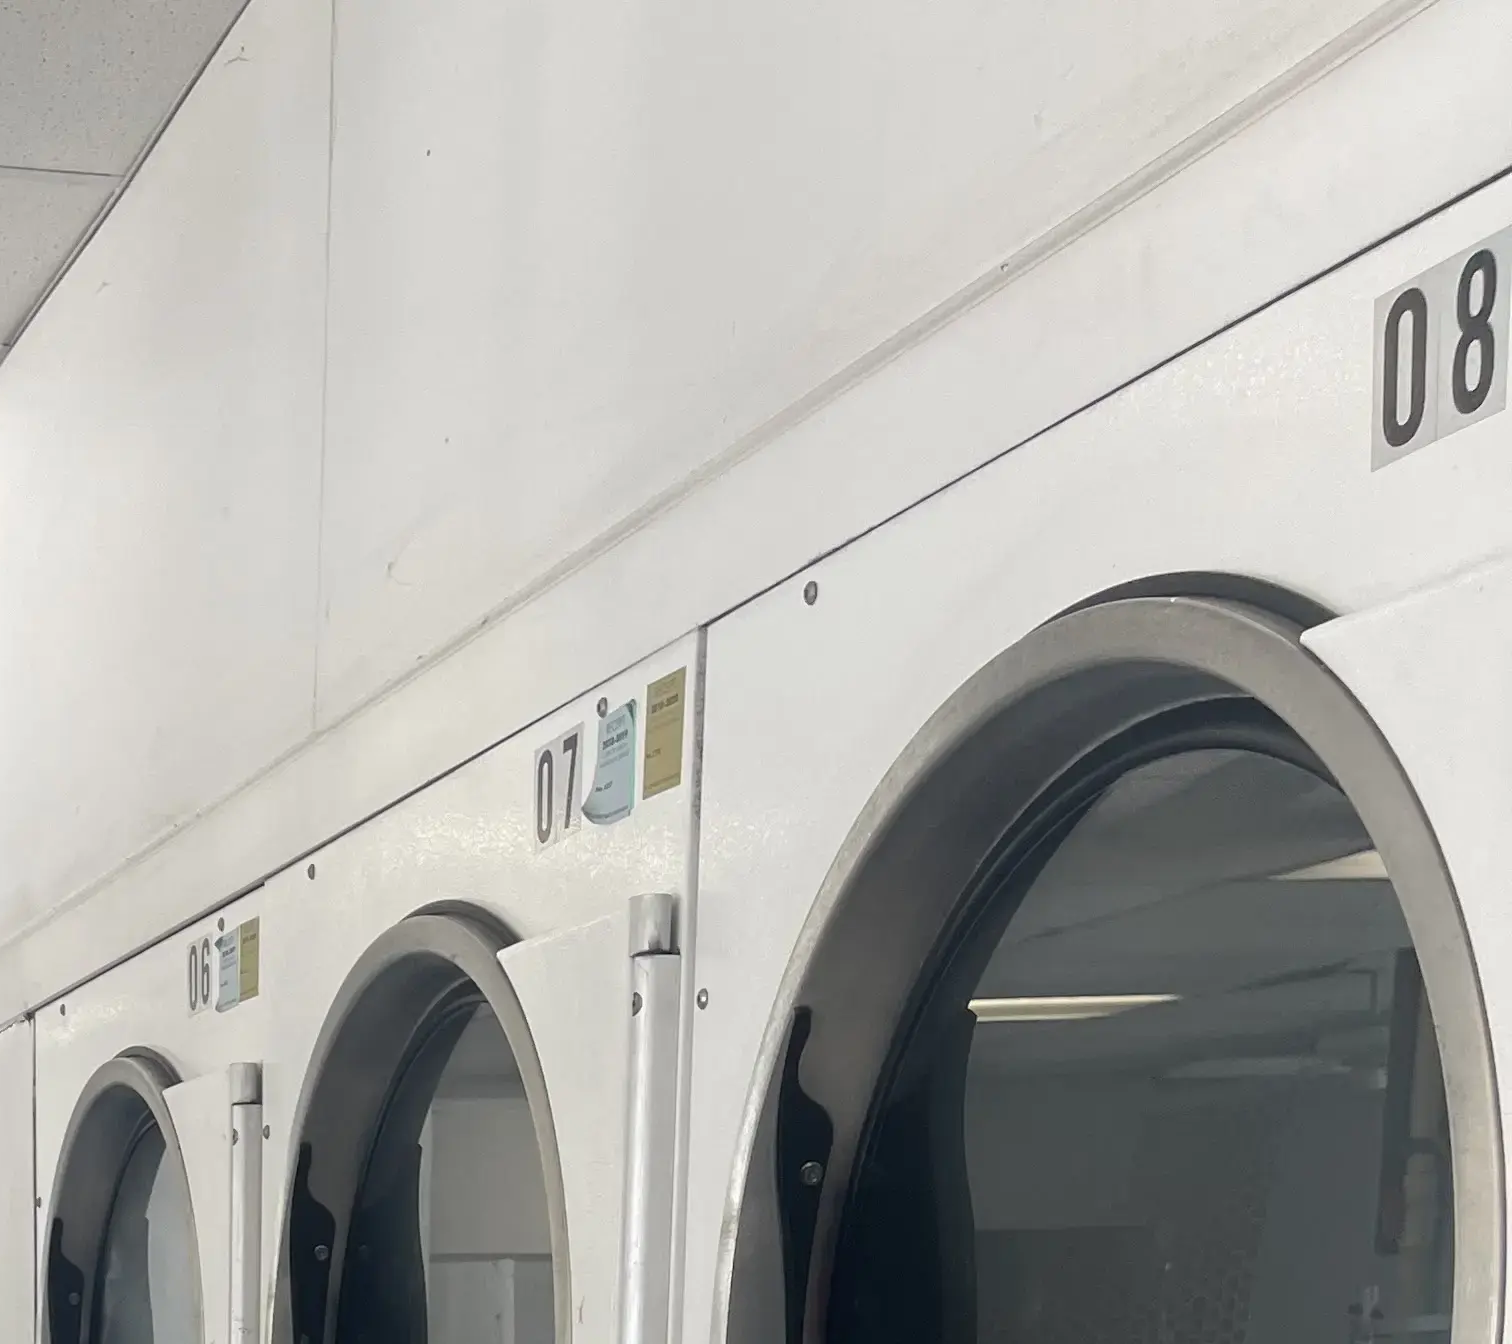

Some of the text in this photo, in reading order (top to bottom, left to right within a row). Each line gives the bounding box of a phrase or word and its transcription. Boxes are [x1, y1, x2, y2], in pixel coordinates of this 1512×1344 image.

[1383, 248, 1497, 447] 08
[537, 732, 578, 844] 07
[189, 938, 210, 1012] 06
